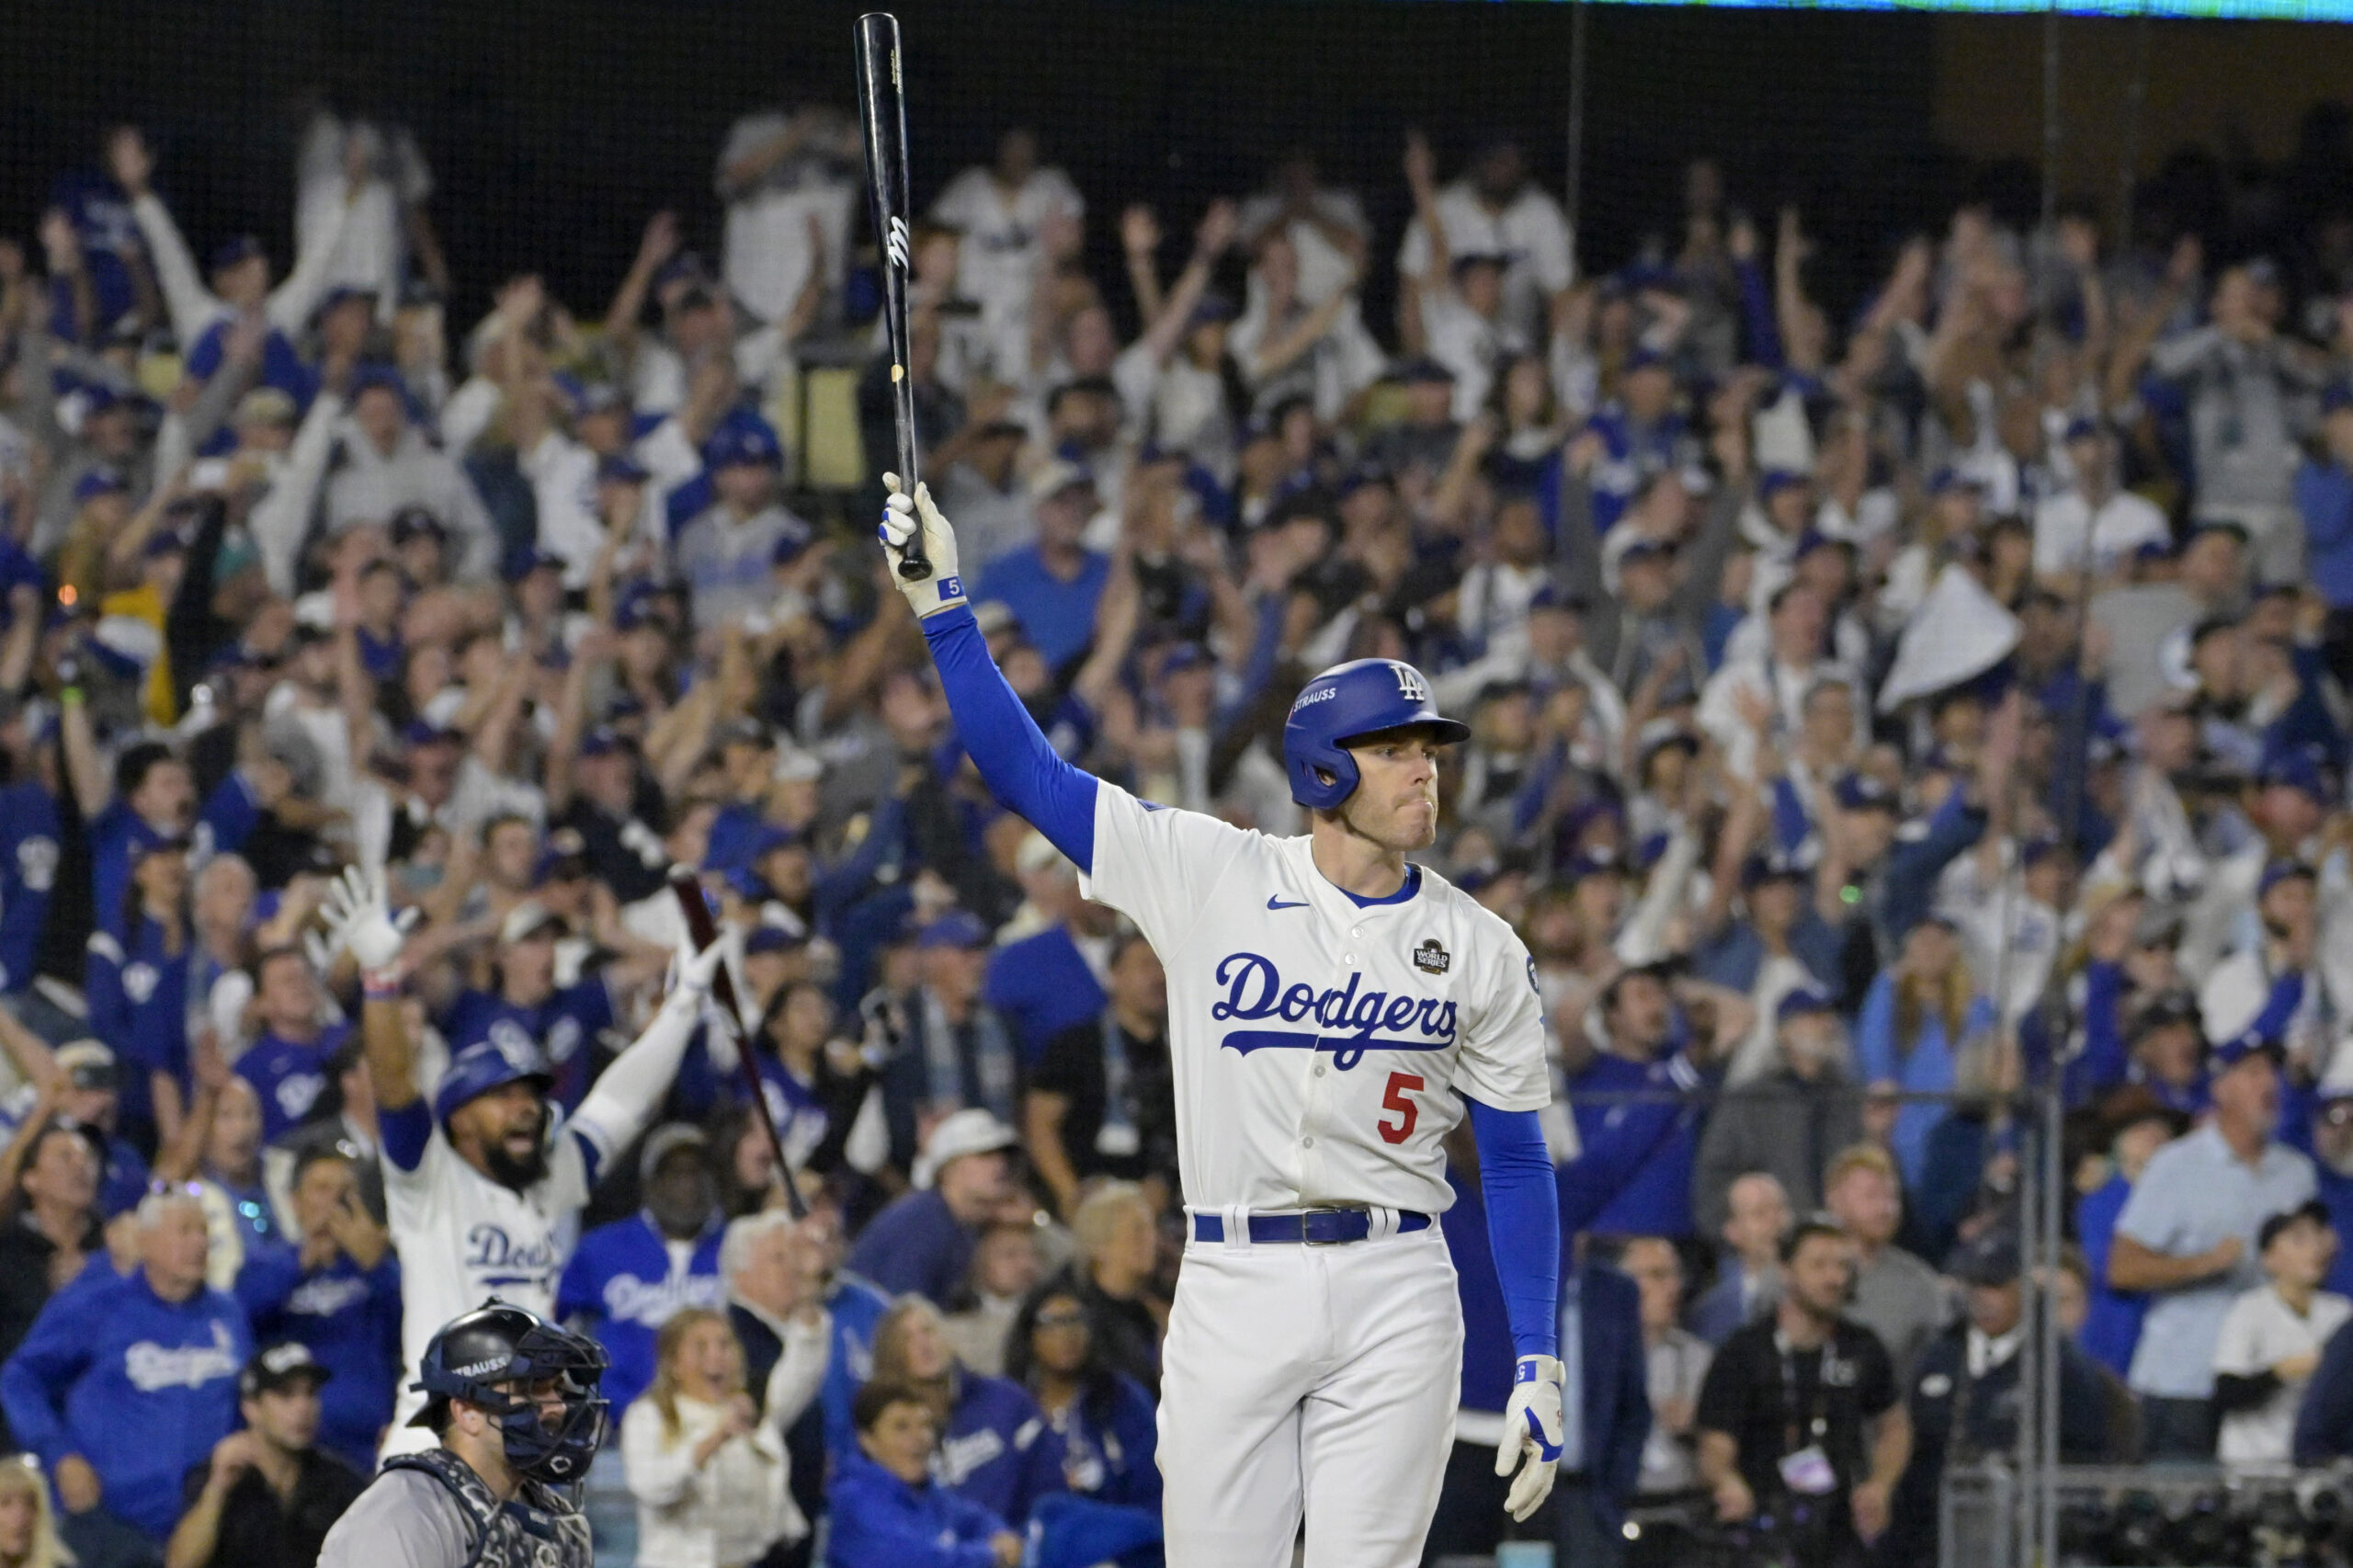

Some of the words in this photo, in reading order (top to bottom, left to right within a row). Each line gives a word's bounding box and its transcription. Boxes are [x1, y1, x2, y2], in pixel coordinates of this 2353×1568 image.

[949, 579, 961, 596] 5
[1389, 665, 1425, 700] LA
[1293, 687, 1336, 712] STRAUSS
[1416, 949, 1449, 961] WORLD
[1417, 956, 1447, 969] SERIES
[1211, 951, 1458, 1072] Dodgers
[1377, 1071, 1425, 1145] 5
[451, 1356, 506, 1377] TRAUSS
